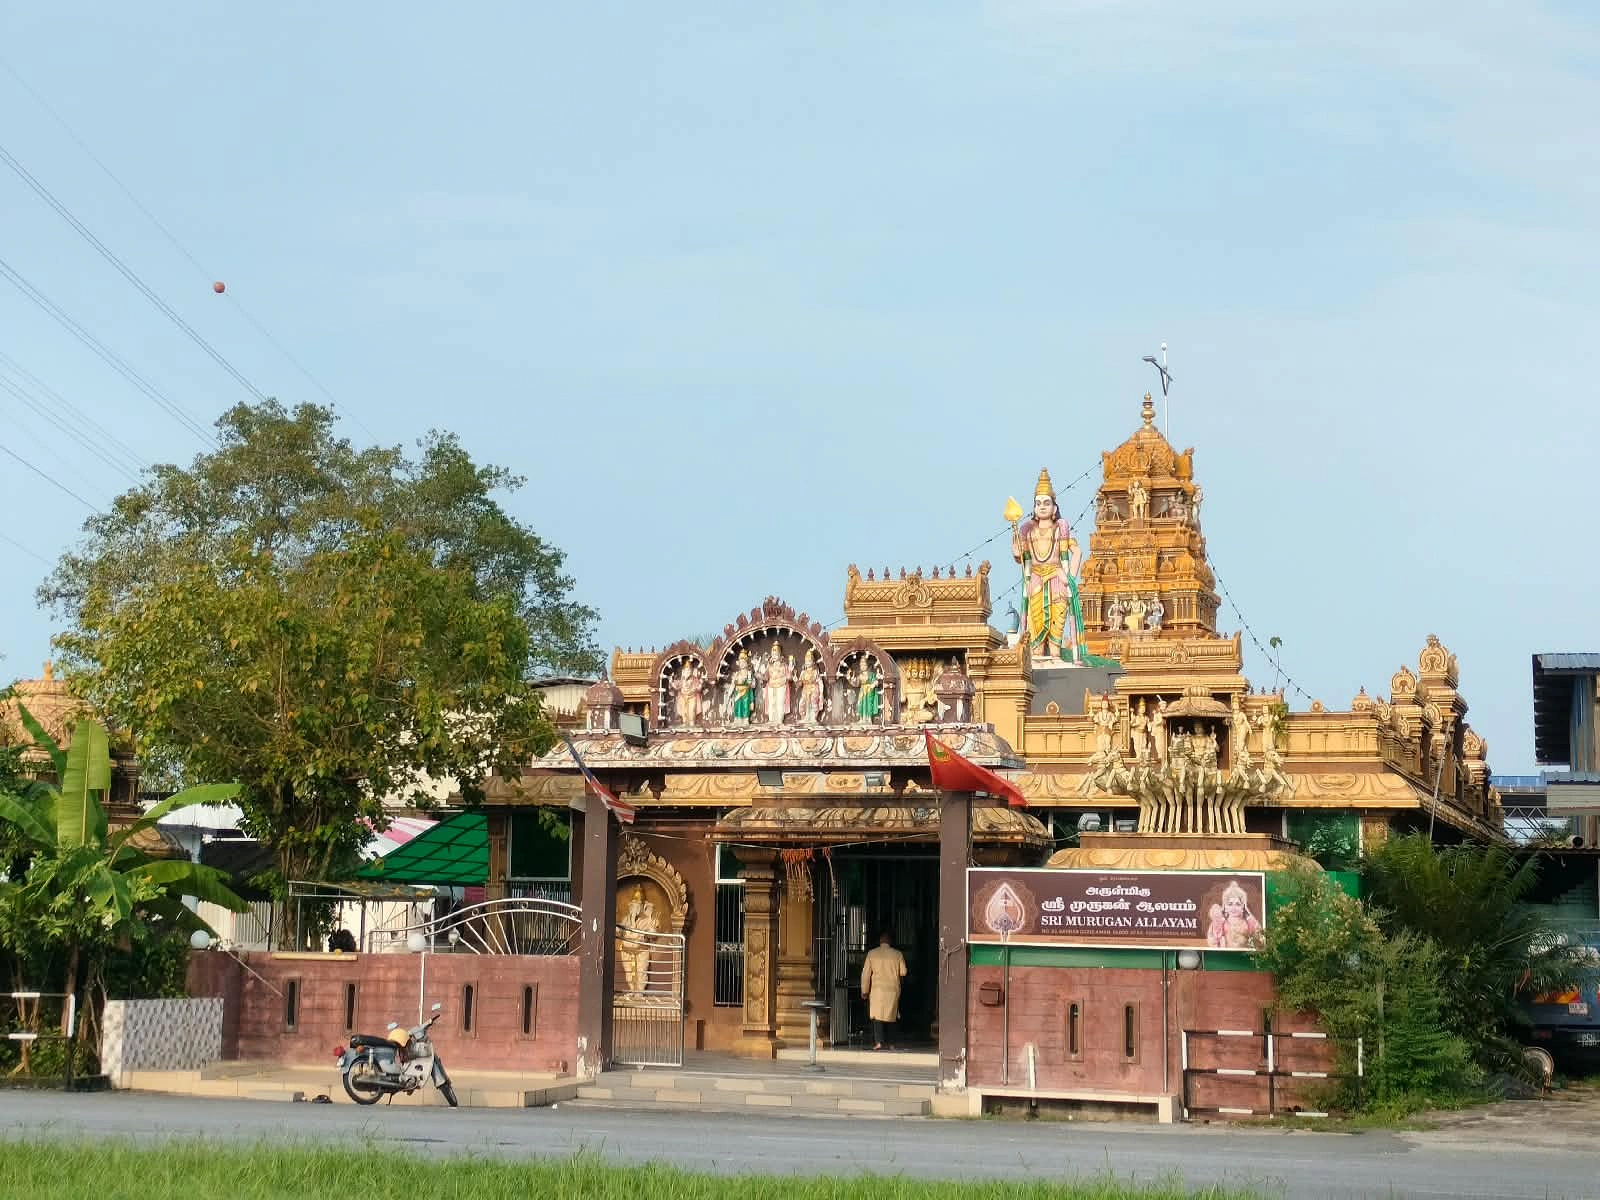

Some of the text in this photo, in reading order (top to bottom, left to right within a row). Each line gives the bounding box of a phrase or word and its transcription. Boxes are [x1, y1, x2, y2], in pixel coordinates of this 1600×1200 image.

[1085, 885, 1151, 897] அருள்மிகு
[1069, 897, 1131, 912] முருகன்
[1136, 899, 1197, 912] ஆலயம்
[1040, 915, 1197, 928] SRI MURUGAN ALLAYAM
